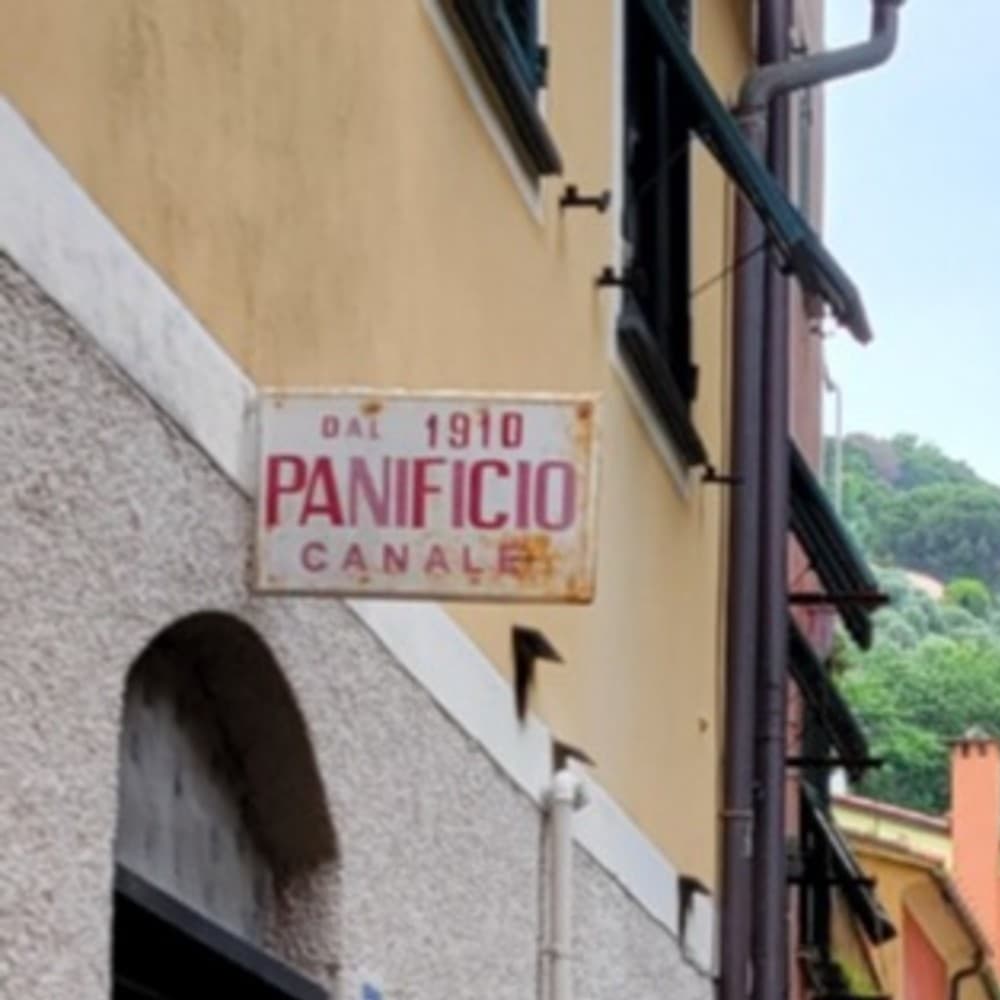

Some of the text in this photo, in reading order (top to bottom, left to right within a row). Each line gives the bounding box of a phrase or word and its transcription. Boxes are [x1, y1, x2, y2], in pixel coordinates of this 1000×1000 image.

[321, 408, 524, 450] DAL 1910
[264, 455, 577, 532] PANIFICIO
[300, 541, 522, 577] CANALE
